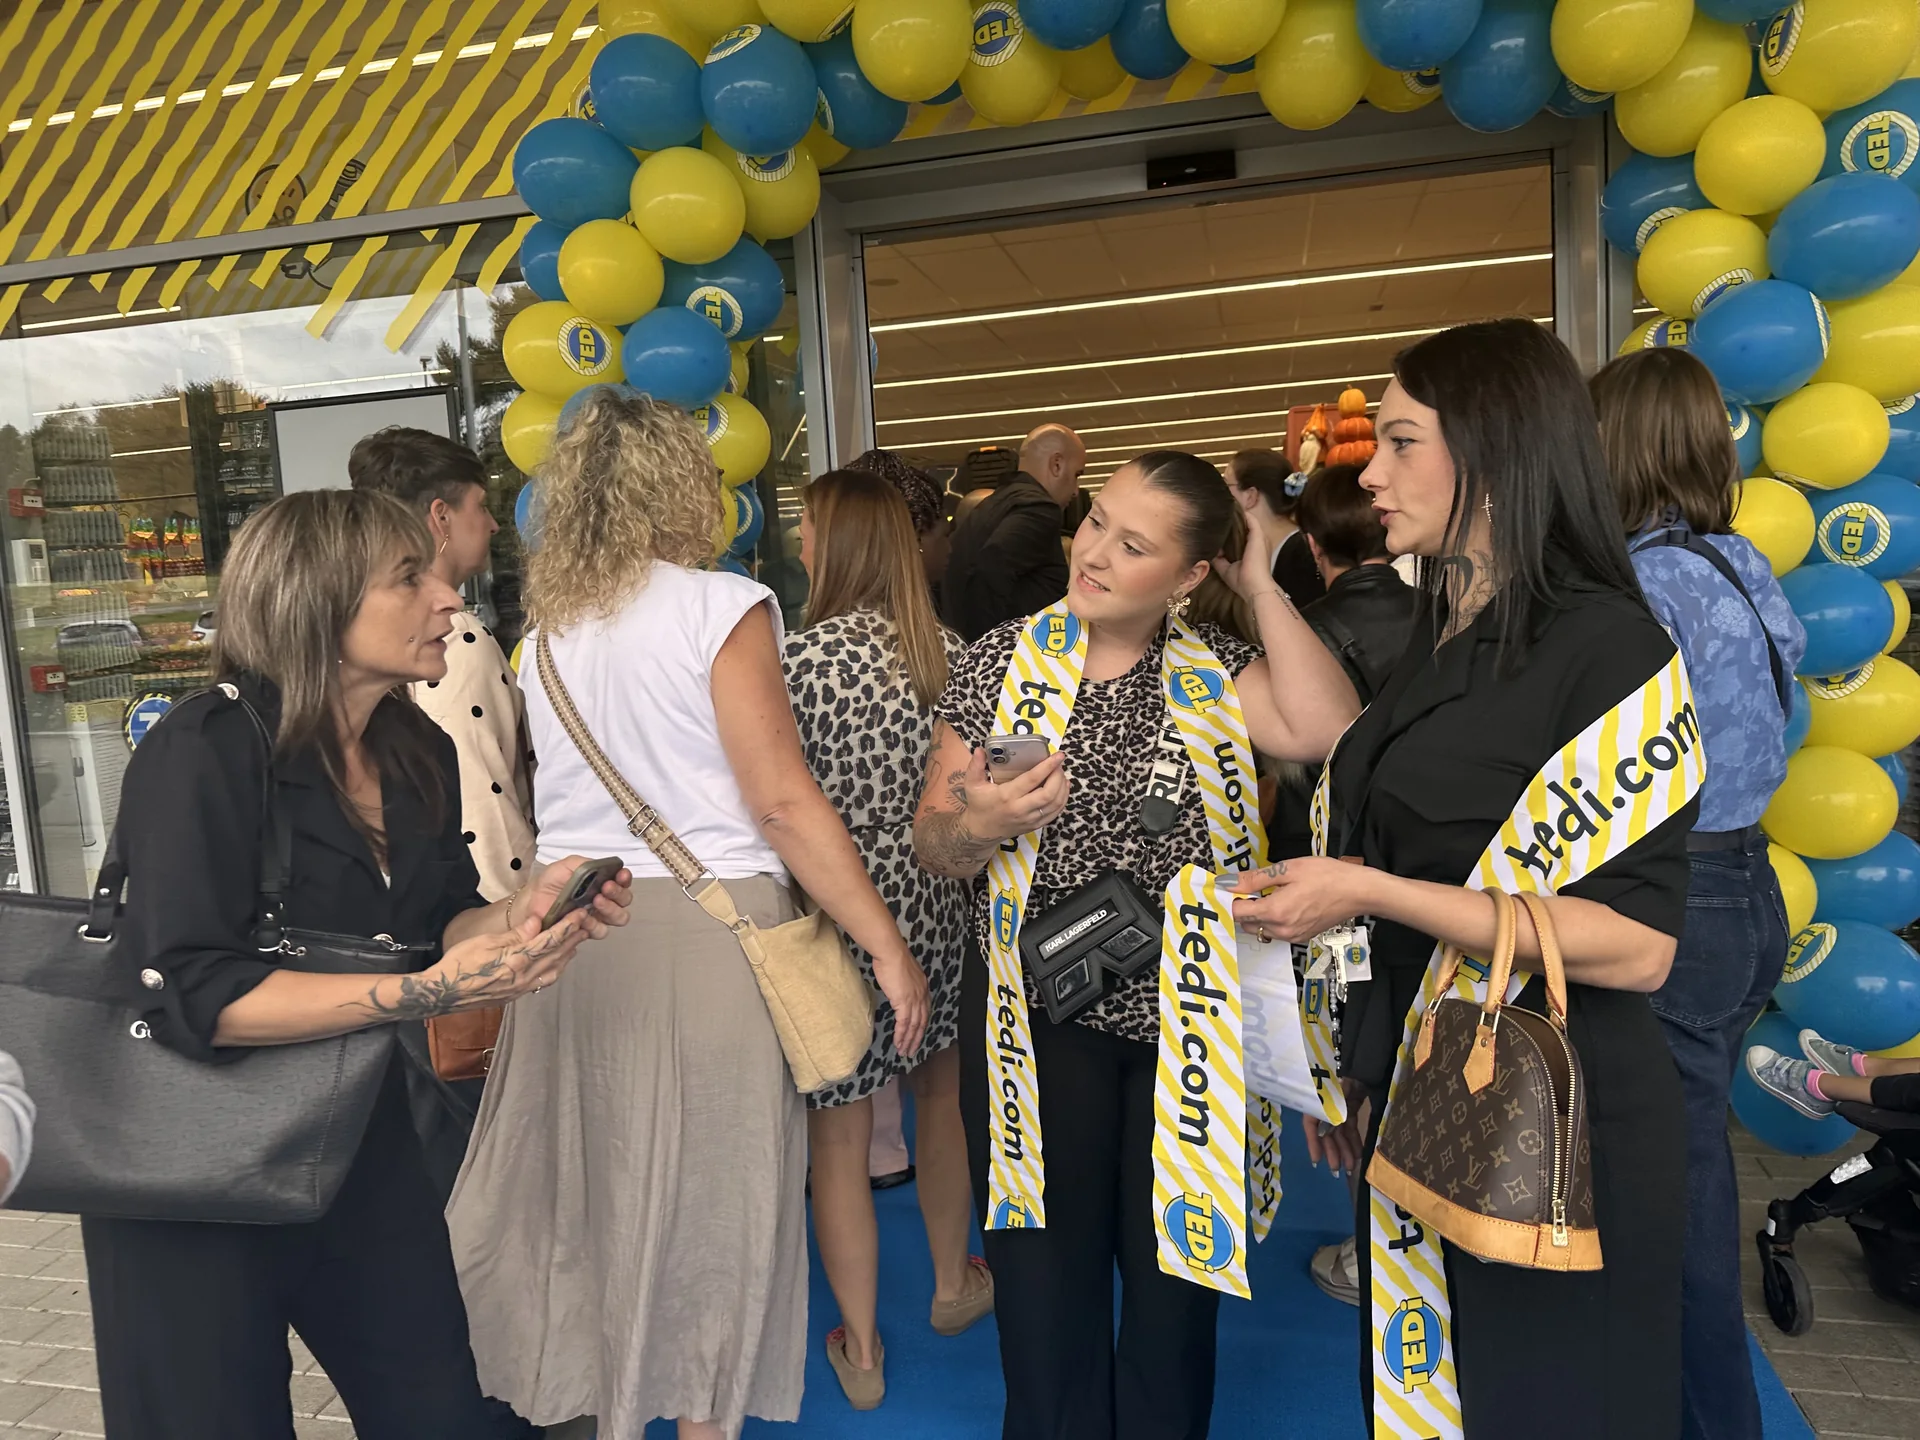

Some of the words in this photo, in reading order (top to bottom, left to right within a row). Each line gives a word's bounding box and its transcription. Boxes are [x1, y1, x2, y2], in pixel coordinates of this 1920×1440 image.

[973, 16, 1020, 46] TED
[576, 322, 597, 370] TEDi
[1839, 507, 1870, 562] TEDi
[1174, 665, 1218, 716] TEDi
[1504, 702, 1700, 881] tedi.com
[1000, 886, 1016, 955] TEDi
[1044, 935, 1066, 953] KARL
[1063, 908, 1108, 941] LAGERFELD
[1177, 901, 1227, 1147] tedi.com
[997, 984, 1028, 1161] tedi.com
[1183, 1191, 1217, 1276] TEDi
[1400, 1296, 1430, 1394] TEDi
